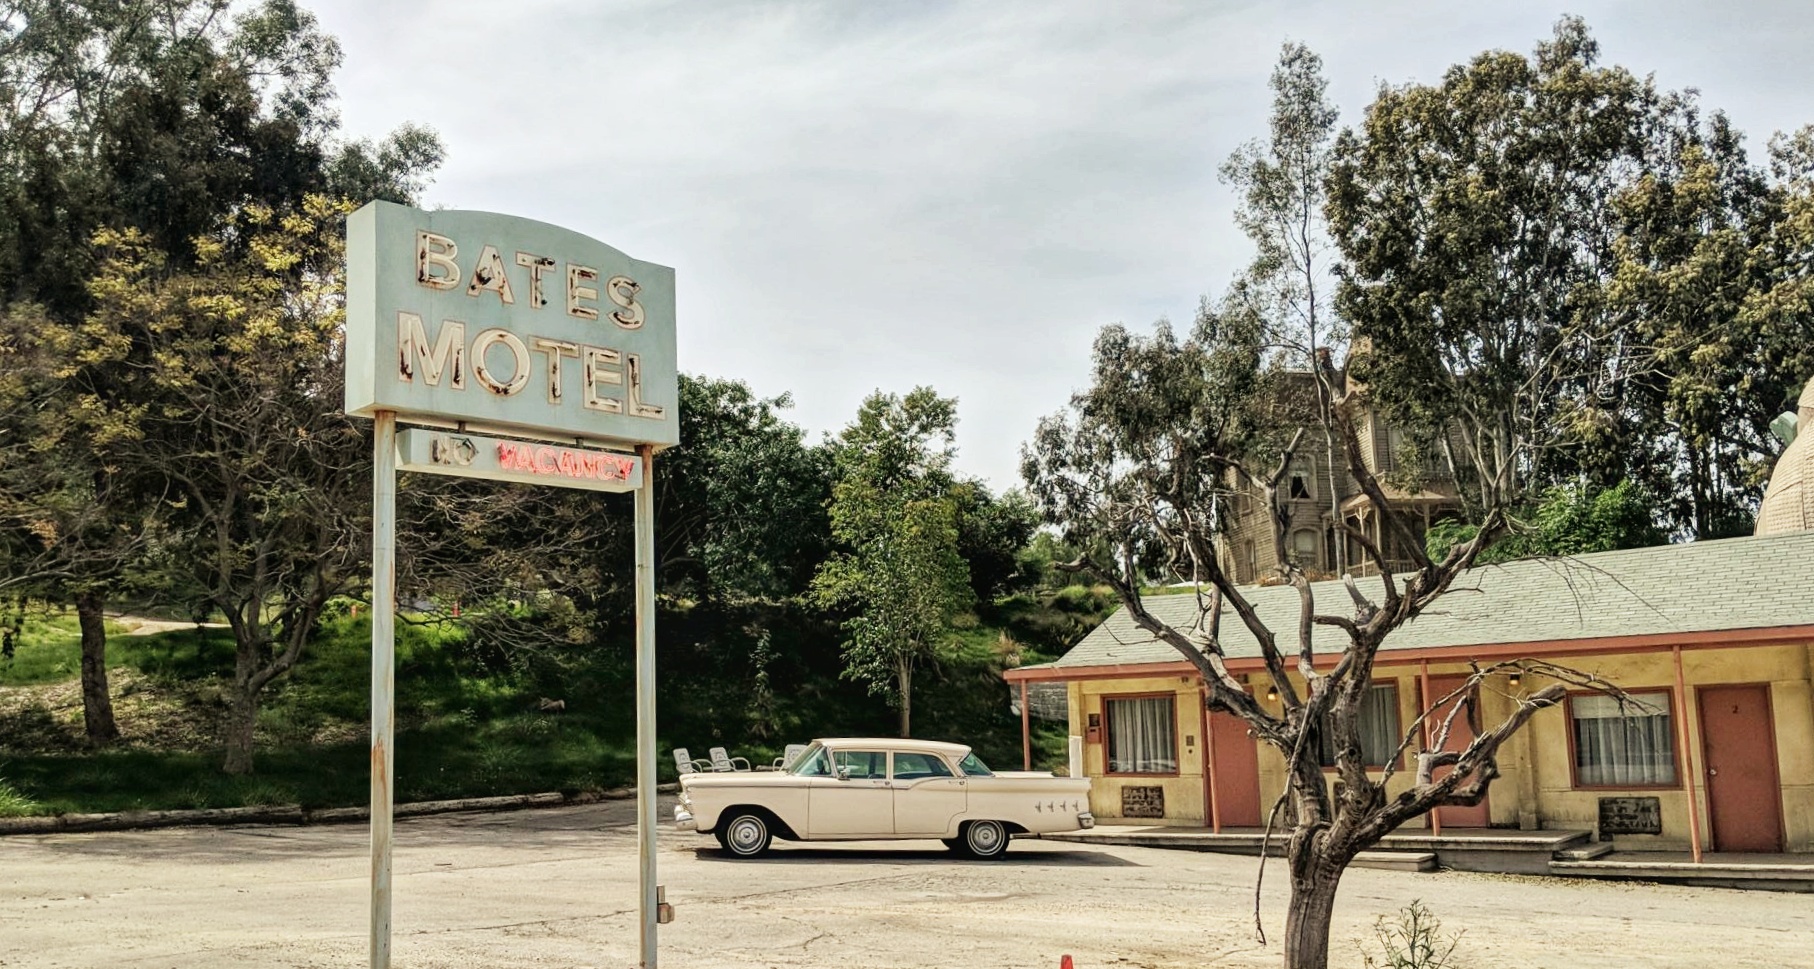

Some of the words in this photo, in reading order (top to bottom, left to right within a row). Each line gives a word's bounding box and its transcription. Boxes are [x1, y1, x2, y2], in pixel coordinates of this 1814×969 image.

[416, 230, 645, 330] BATES
[398, 312, 666, 420] MOTEL
[497, 441, 634, 480] VACANCY
